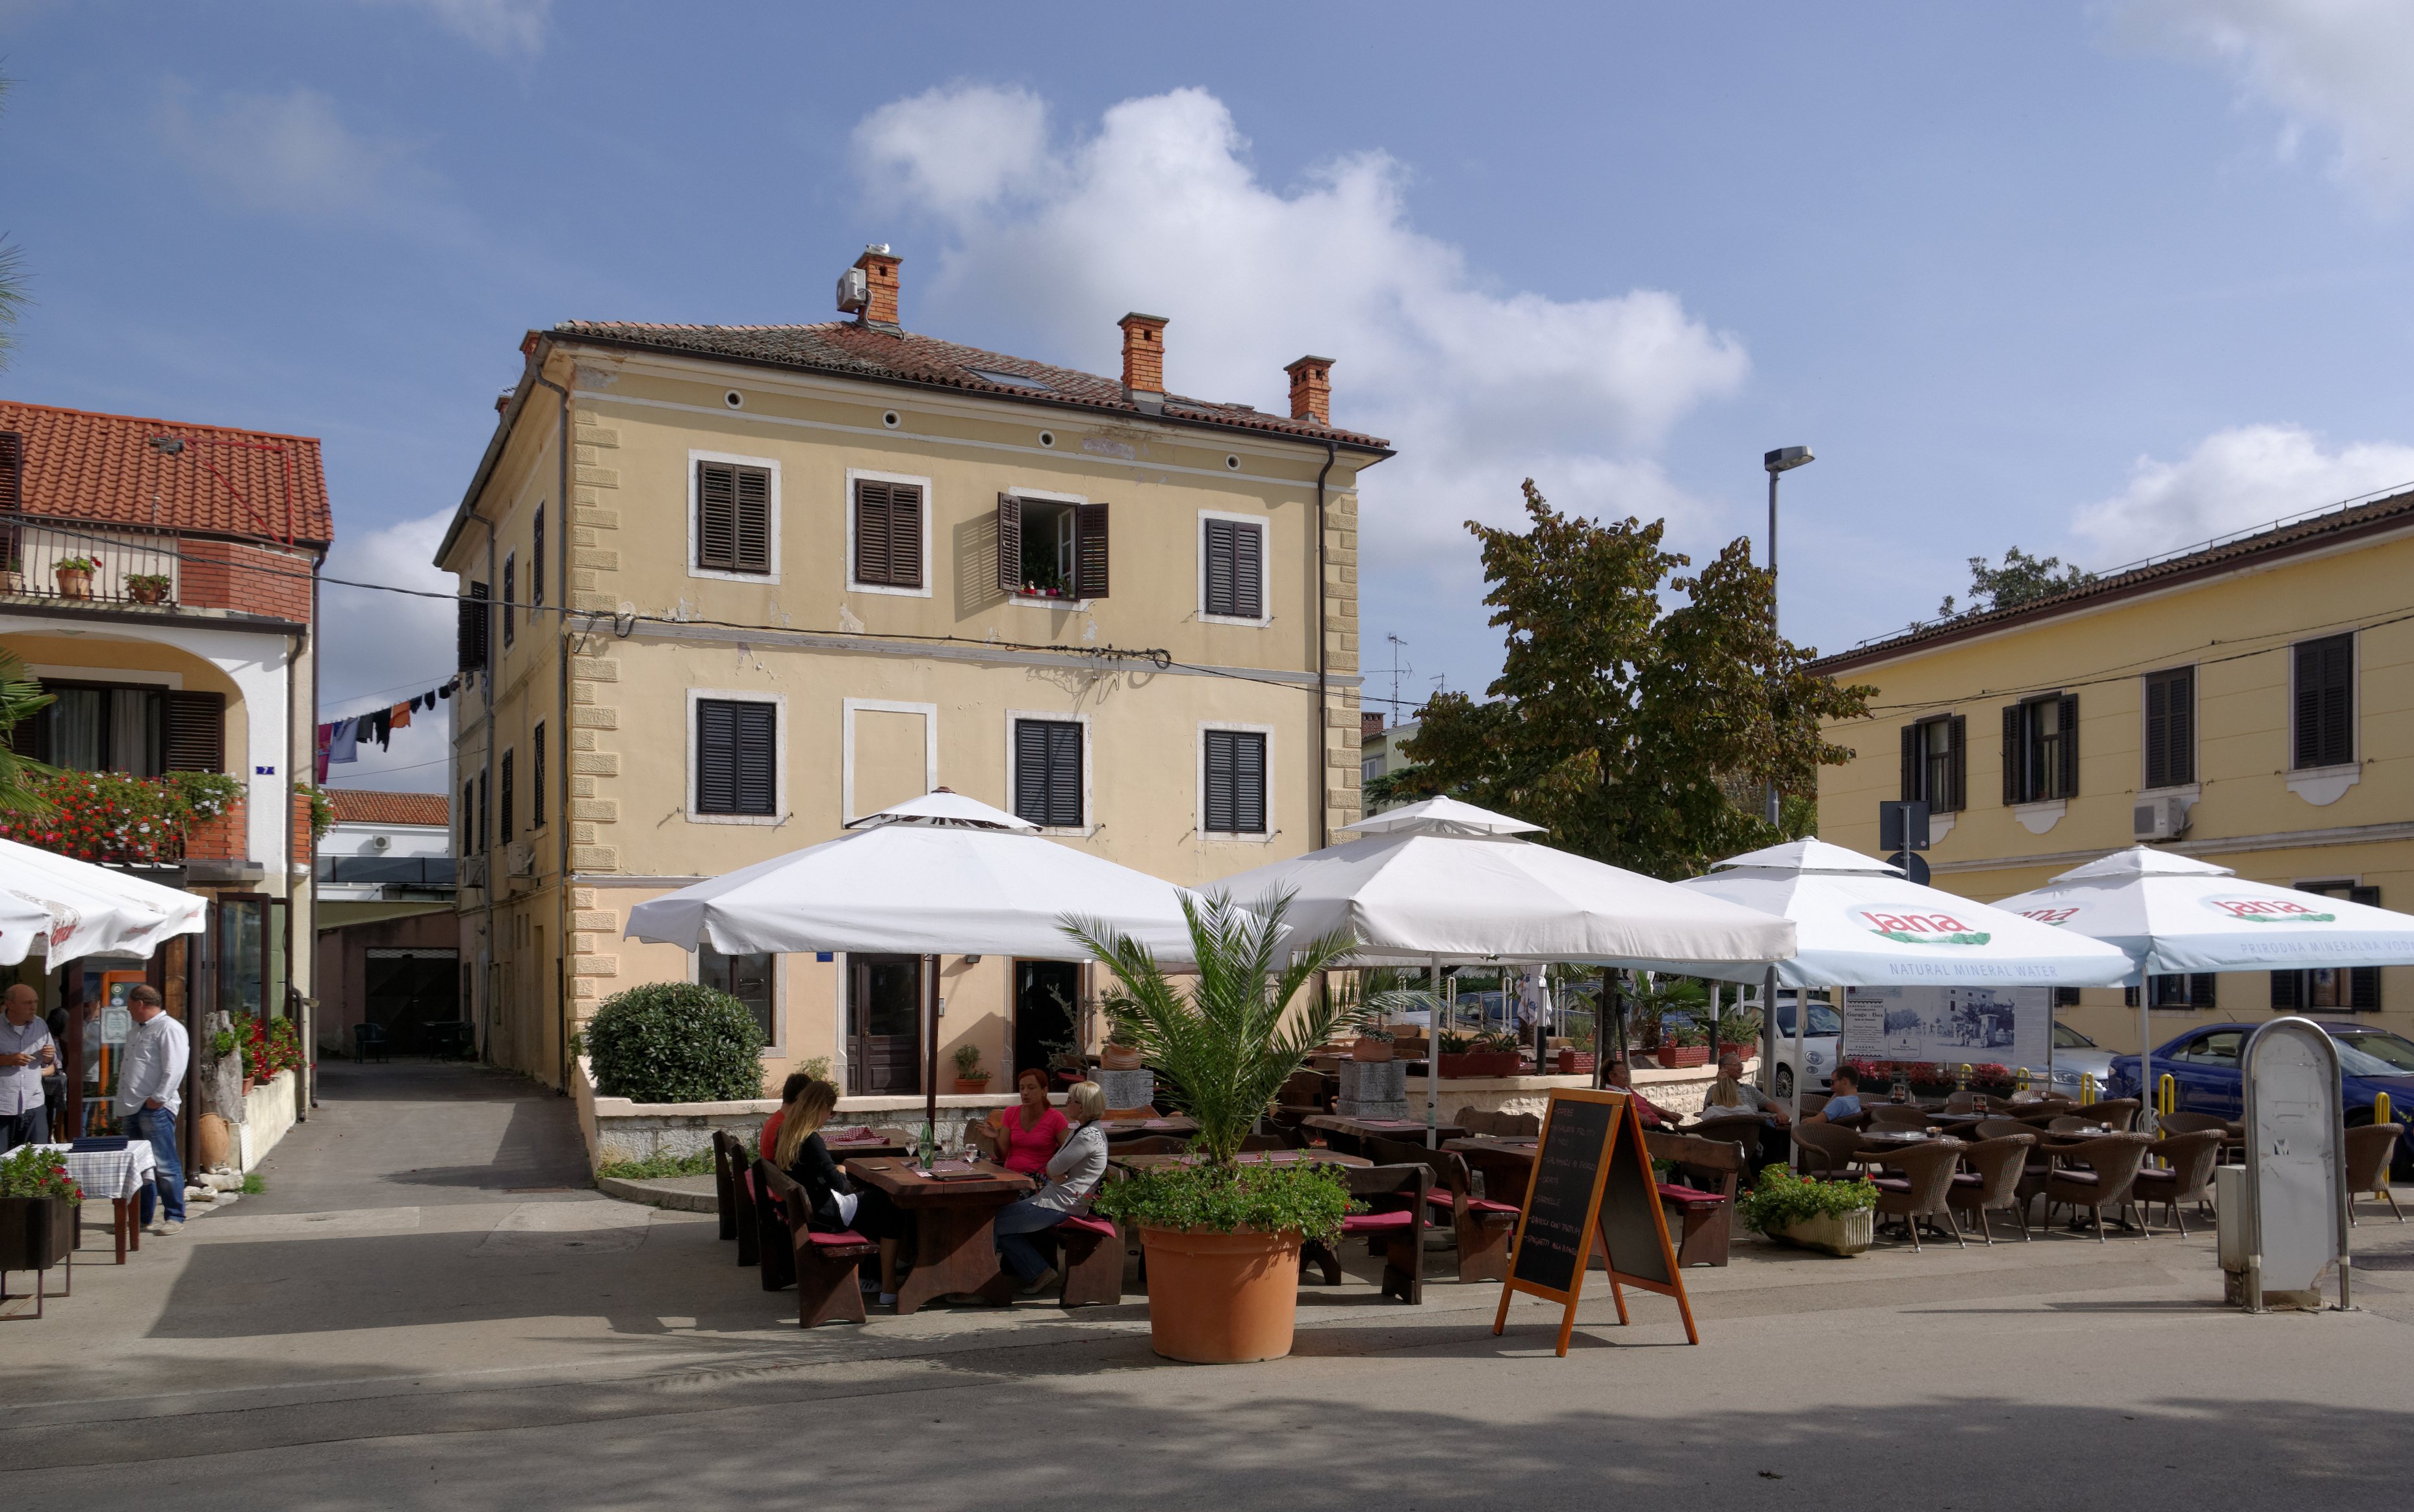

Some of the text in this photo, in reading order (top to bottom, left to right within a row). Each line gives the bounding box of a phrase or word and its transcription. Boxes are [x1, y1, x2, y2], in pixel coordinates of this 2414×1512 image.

[2210, 901, 2318, 917] Jana
[1859, 912, 1974, 933] Jana
[2241, 942, 2305, 954] PRIRODNA
[2309, 940, 2382, 952] MINERALNA
[1890, 964, 2058, 977] NATURAL MINERAL WATER
